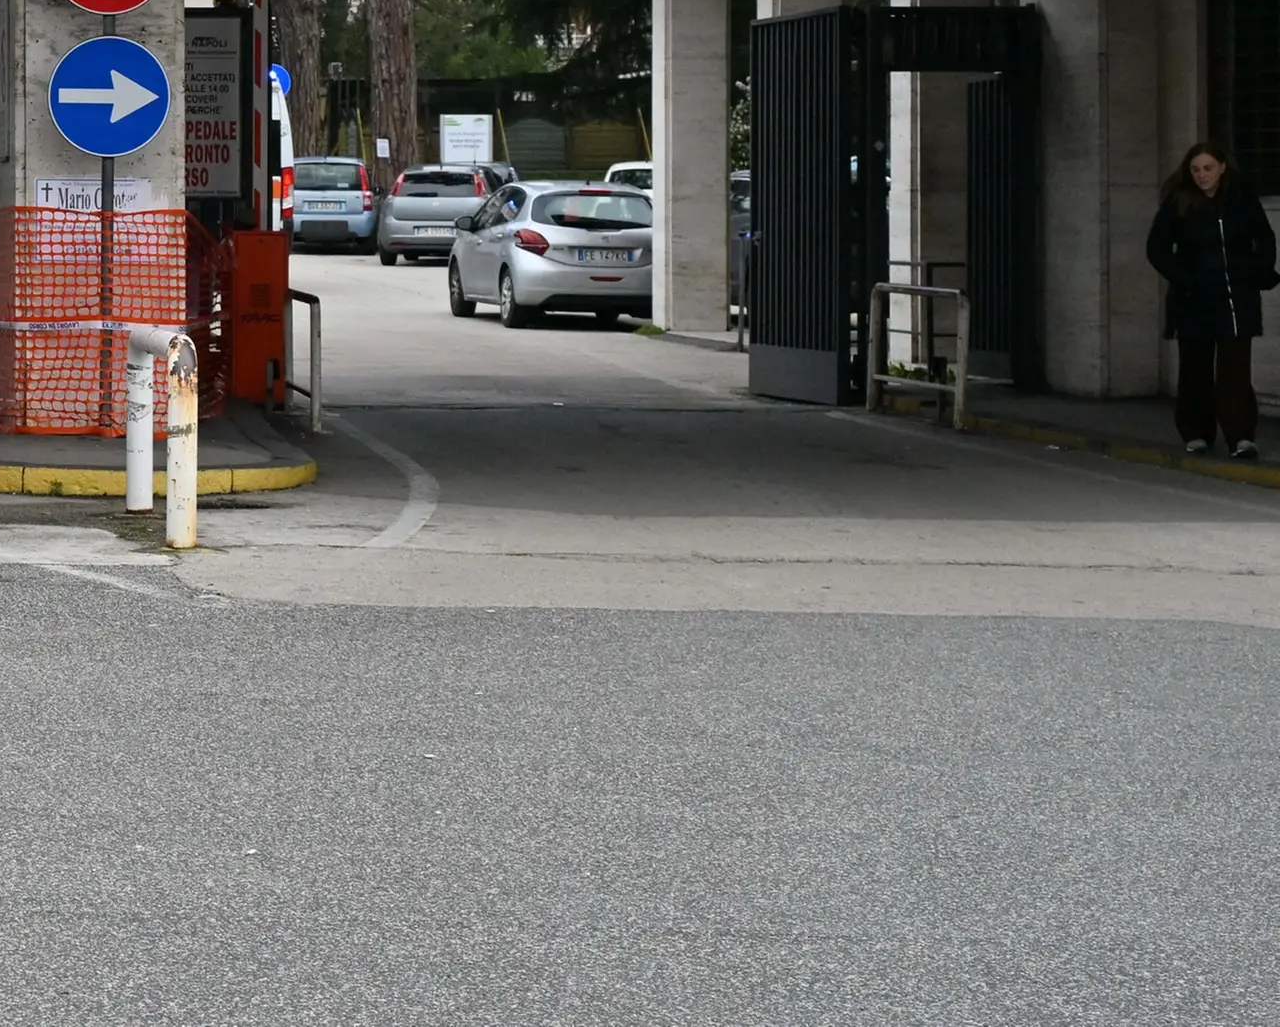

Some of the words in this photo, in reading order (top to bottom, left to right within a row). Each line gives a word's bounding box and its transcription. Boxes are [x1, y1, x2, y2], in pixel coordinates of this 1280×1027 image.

[191, 38, 228, 48] NAPOLI
[185, 121, 237, 140] PEDALE
[57, 187, 91, 211] Mario
